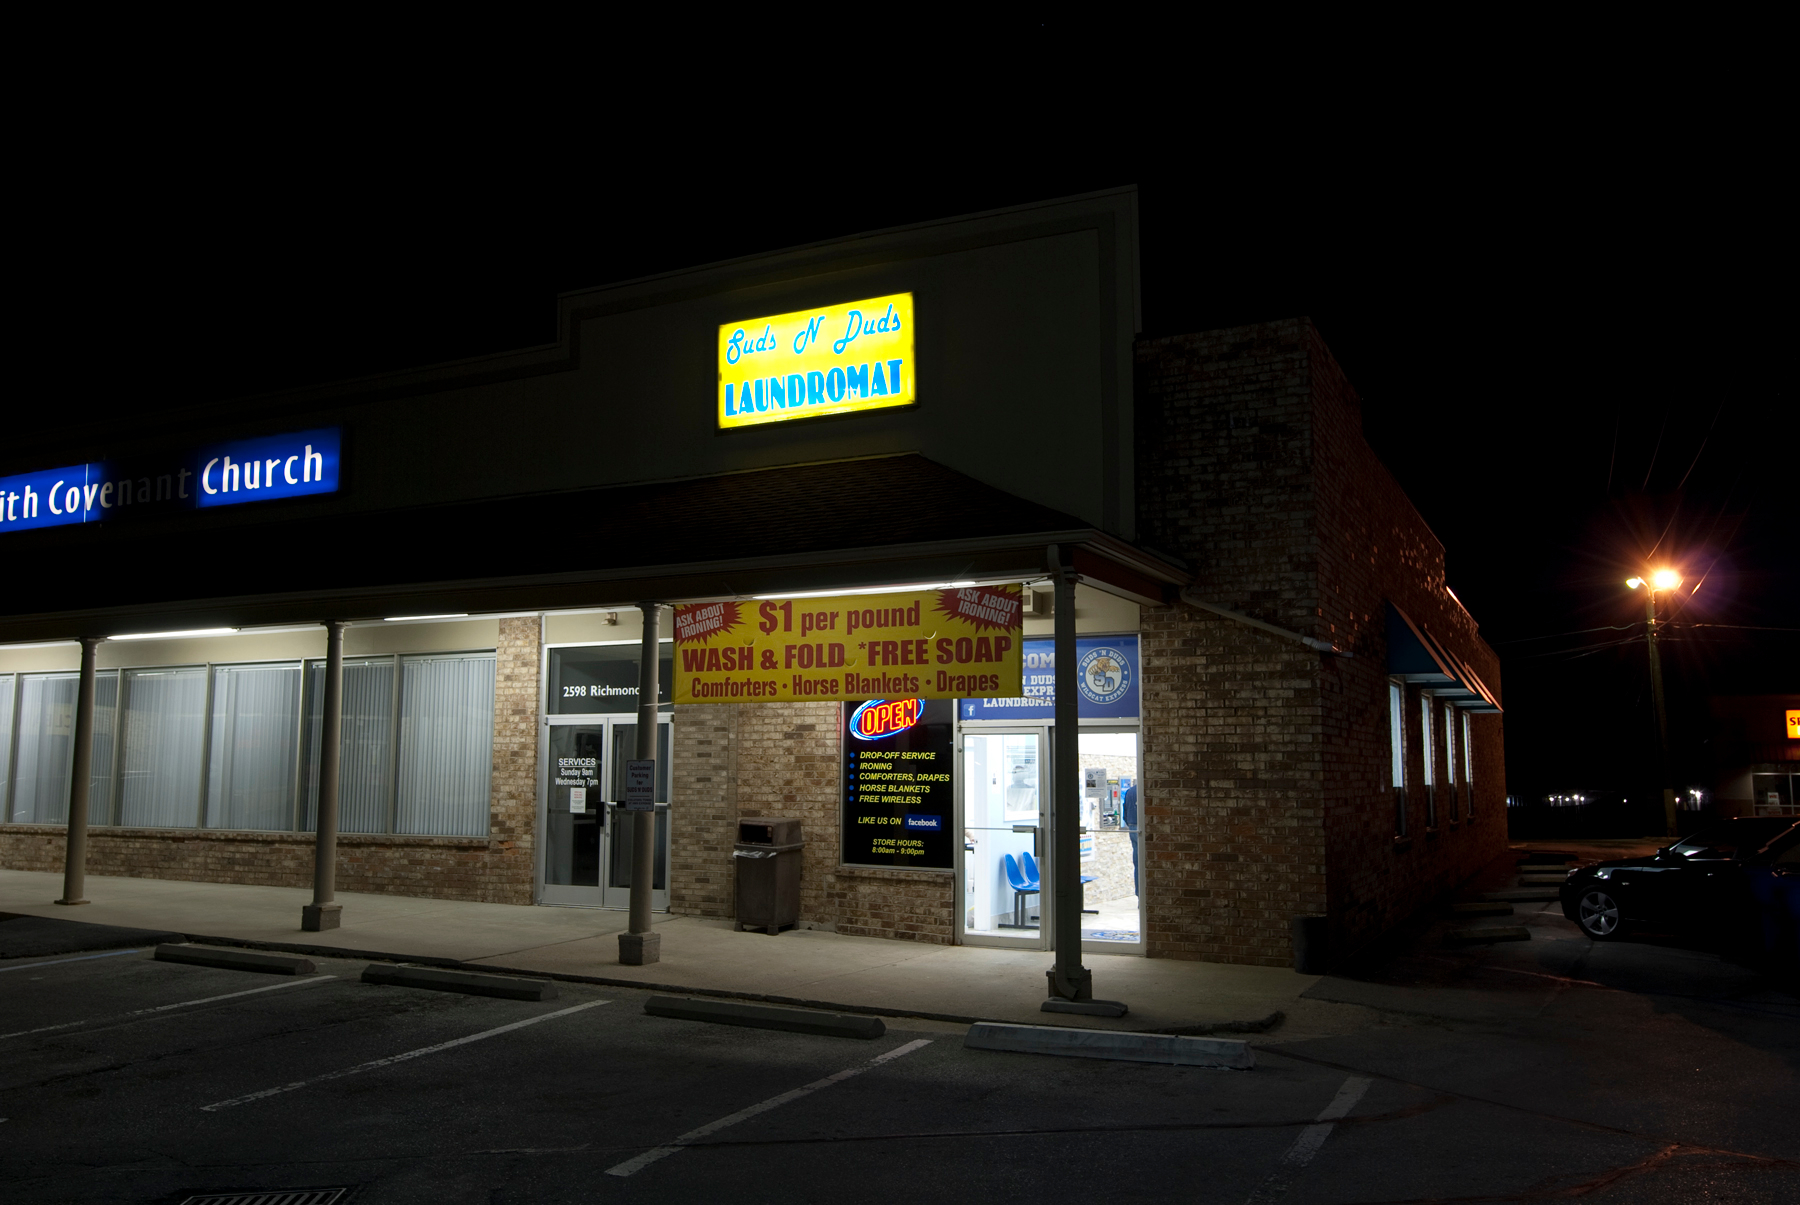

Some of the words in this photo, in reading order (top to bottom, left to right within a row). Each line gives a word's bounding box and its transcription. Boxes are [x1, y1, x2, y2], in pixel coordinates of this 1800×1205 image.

[726, 324, 777, 364] Suds
[793, 315, 825, 354] N
[833, 303, 901, 354] Duds
[725, 359, 903, 417] LAUNDROMAT
[48, 467, 192, 516] Covenant
[202, 444, 324, 495] Church
[957, 587, 981, 604] ASK
[981, 594, 1019, 614] ABOUT
[676, 612, 693, 628] ASK
[695, 603, 725, 620] ABOUT
[758, 600, 792, 636] $1
[801, 611, 840, 638] per
[846, 599, 921, 636] pound
[958, 600, 1010, 626] IRONING!
[680, 616, 724, 638] IRONING!
[682, 646, 754, 673] WASH
[760, 648, 778, 670] &
[784, 642, 845, 670] FOLD
[935, 635, 1012, 665] SOAP
[1082, 652, 1098, 668] SUDS
[1108, 650, 1126, 666] DUDS
[692, 676, 778, 698] Comforters
[792, 674, 840, 696] Horse
[844, 672, 920, 694] Blankets
[936, 670, 1000, 697] Drapes
[1024, 686, 1055, 696] EXPR
[1080, 682, 1104, 702] WILDCAT
[1105, 680, 1128, 702] EXPRESS
[562, 686, 587, 698] 2598
[862, 698, 917, 736] OPEN
[558, 757, 596, 766] SERVICES
[860, 752, 900, 760] DROP-OFF
[901, 752, 936, 760] SERVICE
[560, 768, 581, 778] Sunday
[582, 768, 594, 776] 9am
[860, 762, 892, 770] IRONING
[554, 777, 586, 788] Wednesday
[586, 777, 598, 788] 7pm
[859, 772, 916, 782] COMFORTERS,
[916, 774, 950, 782] DRAPES
[859, 784, 887, 792] HORSE
[888, 785, 931, 793] BLANKETS
[881, 796, 922, 804] WIRELESS
[858, 816, 876, 824] LIKE
[876, 816, 888, 824] US
[890, 817, 902, 825] ON
[908, 818, 938, 827] facebook
[872, 838, 896, 846] STORE
[898, 840, 924, 848] HOURS:
[900, 847, 924, 856] 9:00pm
